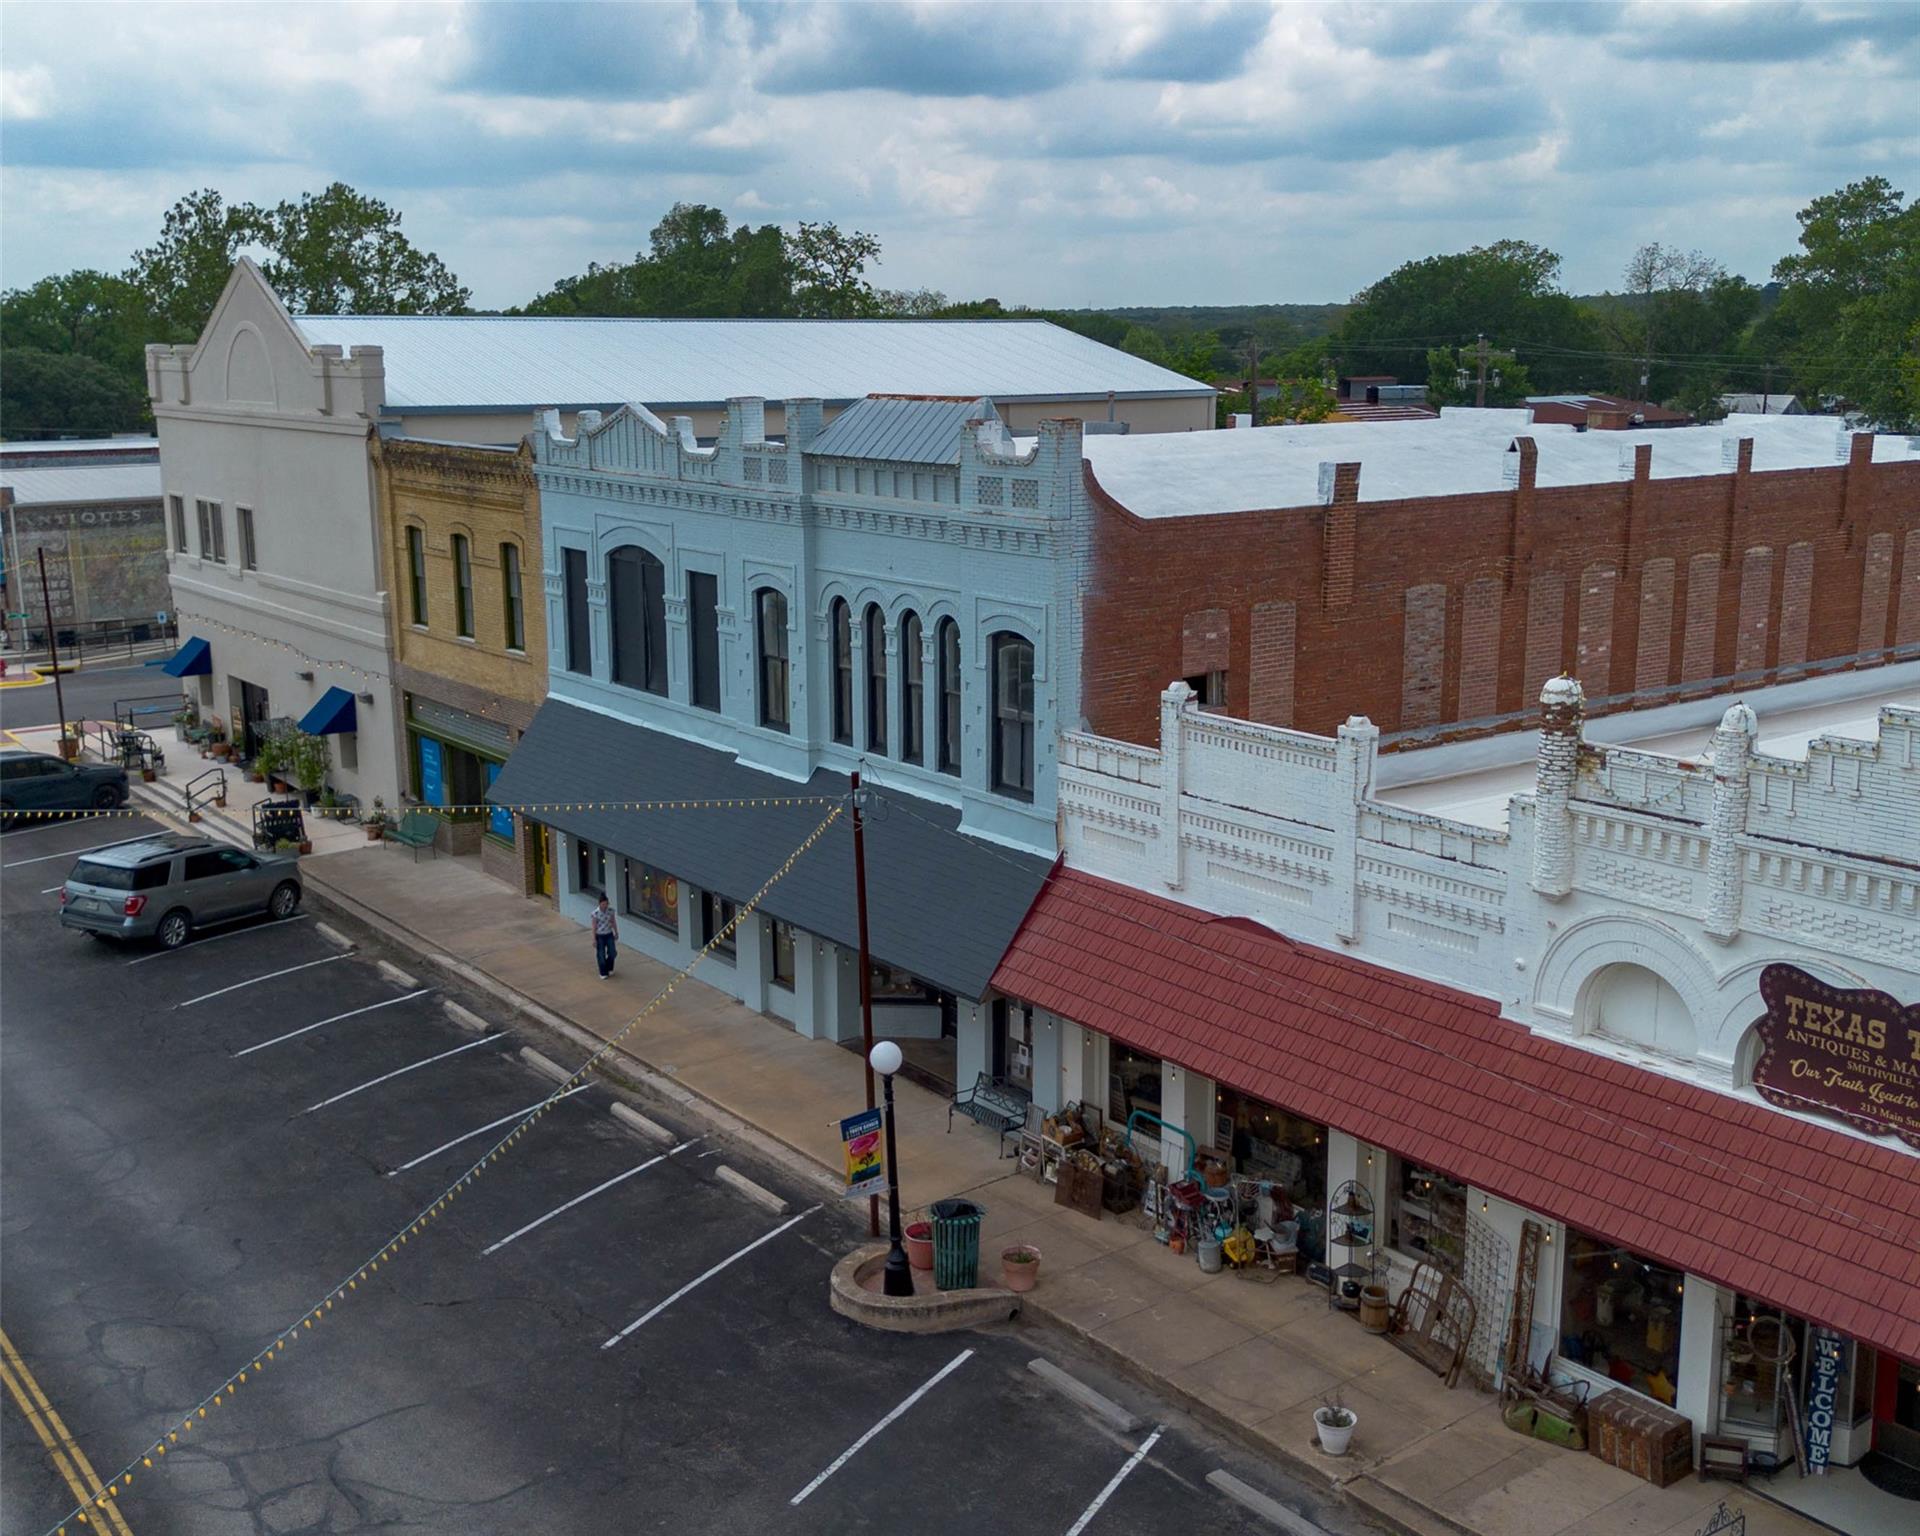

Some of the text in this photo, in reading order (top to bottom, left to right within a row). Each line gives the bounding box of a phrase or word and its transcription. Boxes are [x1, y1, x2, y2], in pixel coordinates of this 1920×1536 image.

[21, 509, 142, 526] ANTIQUES
[1785, 995, 1887, 1050] TEXAS
[1786, 1029, 1870, 1063] ANTIQUES
[1875, 1055, 1888, 1068] &
[1823, 1067, 1866, 1093] Trails
[1868, 1082, 1904, 1104] Lead
[1903, 1095, 1919, 1109] to
[1860, 1102, 1877, 1115] 213
[1880, 1107, 1904, 1123] Main
[1809, 1338, 1840, 1464] WELCOME
